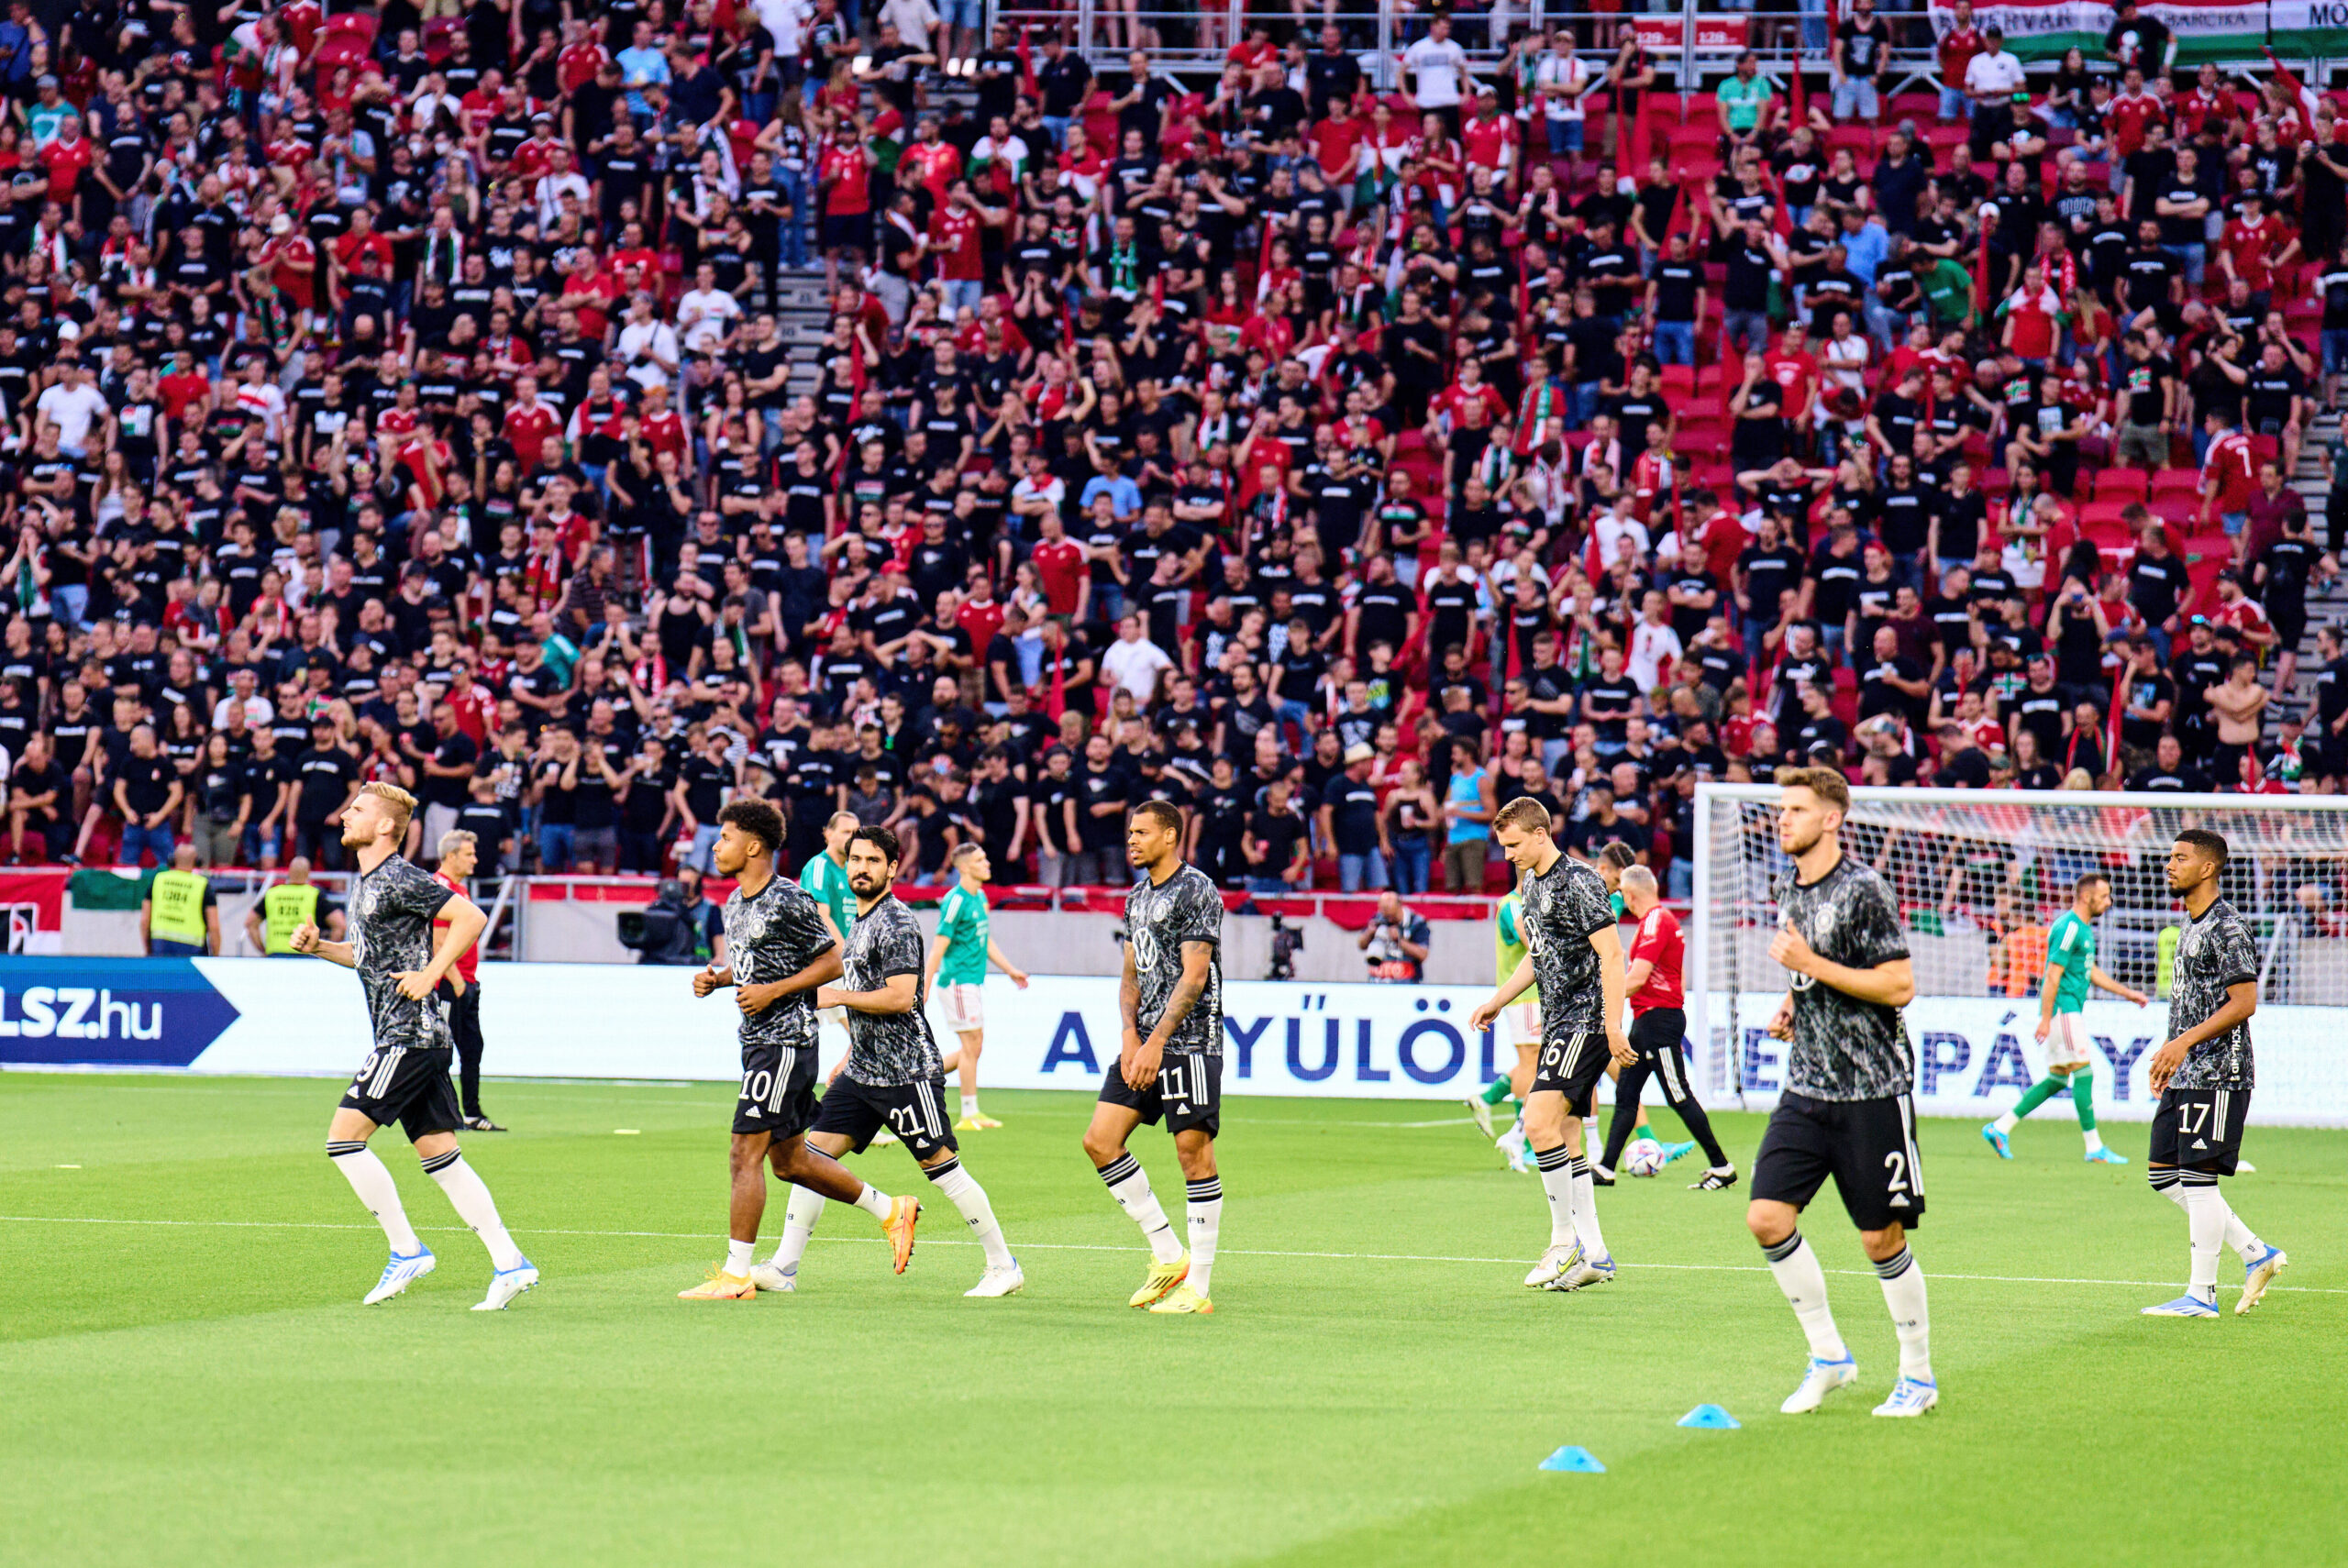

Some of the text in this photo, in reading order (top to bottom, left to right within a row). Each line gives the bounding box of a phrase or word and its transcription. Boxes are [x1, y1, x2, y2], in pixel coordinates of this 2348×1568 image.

[1040, 1011, 1101, 1073] A
[356, 1052, 379, 1082] 9
[1158, 1066, 1190, 1100] 11
[738, 1069, 771, 1102] 10
[890, 1104, 925, 1136] 21
[2178, 1102, 2210, 1133] 17
[1884, 1150, 1909, 1192] 2
